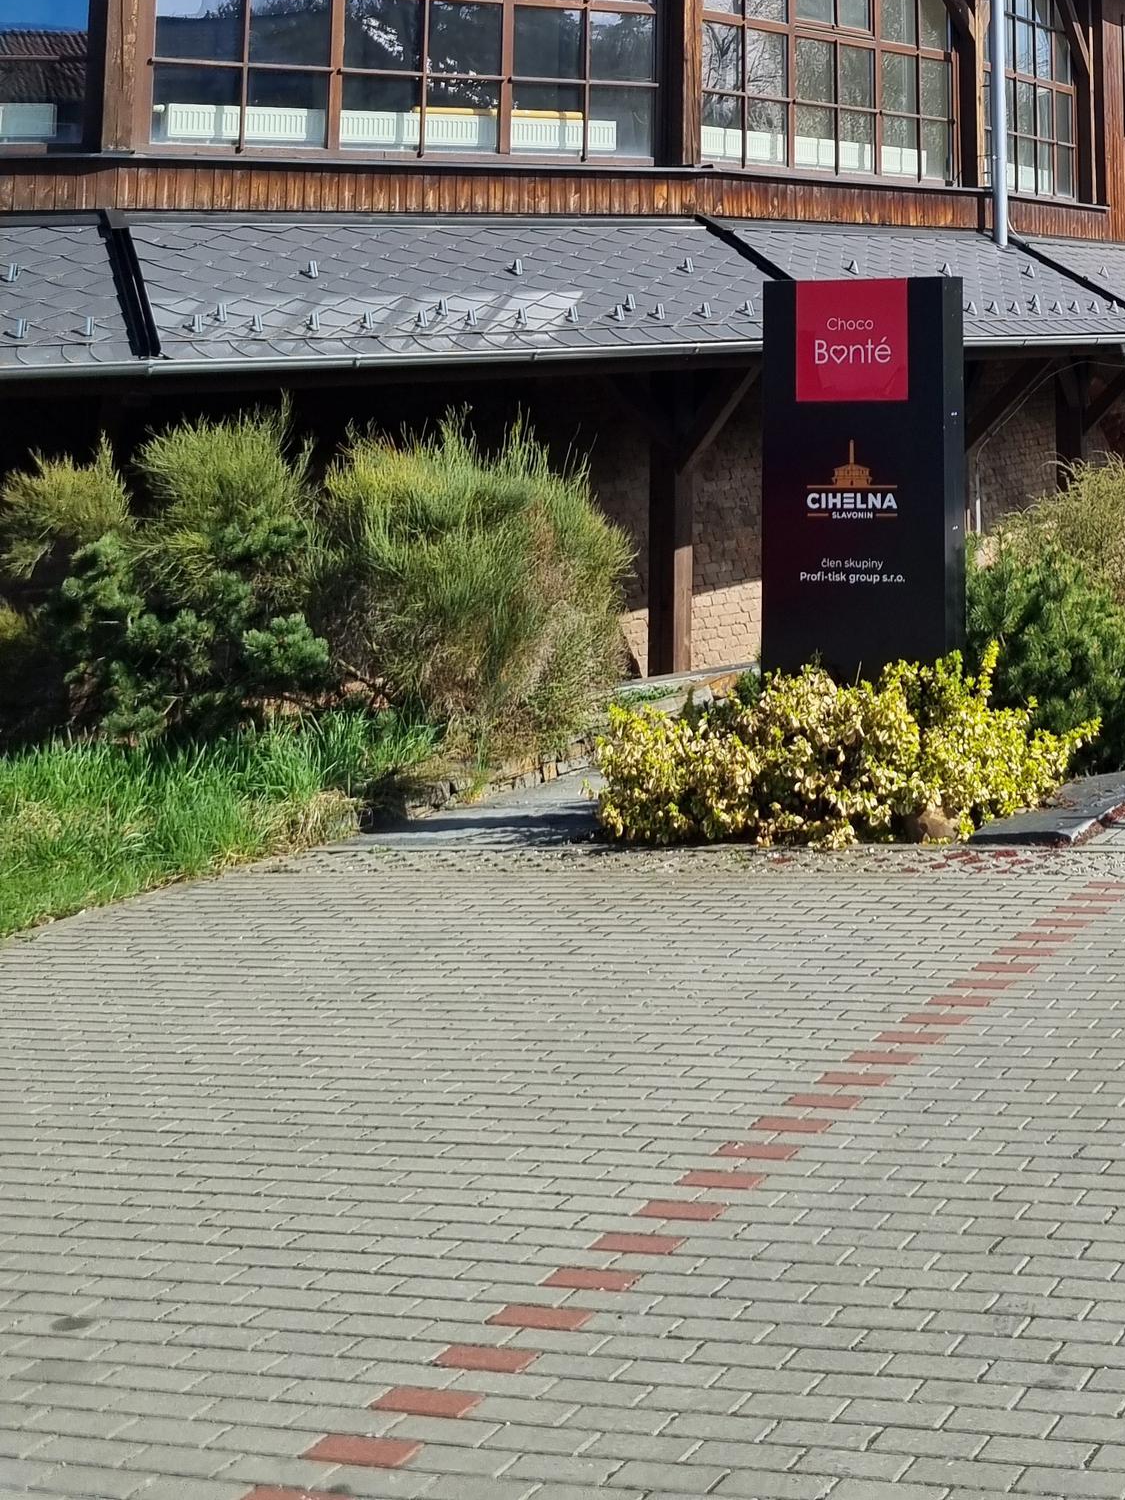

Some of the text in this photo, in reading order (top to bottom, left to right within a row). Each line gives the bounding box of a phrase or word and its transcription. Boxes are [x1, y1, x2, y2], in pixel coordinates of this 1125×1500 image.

[826, 317, 875, 331] Choco
[814, 336, 892, 365] Bonté
[806, 492, 898, 509] CIHELNA
[821, 557, 884, 571] člen skupiny
[800, 571, 906, 585] Profi-tisk group s.r.o.
